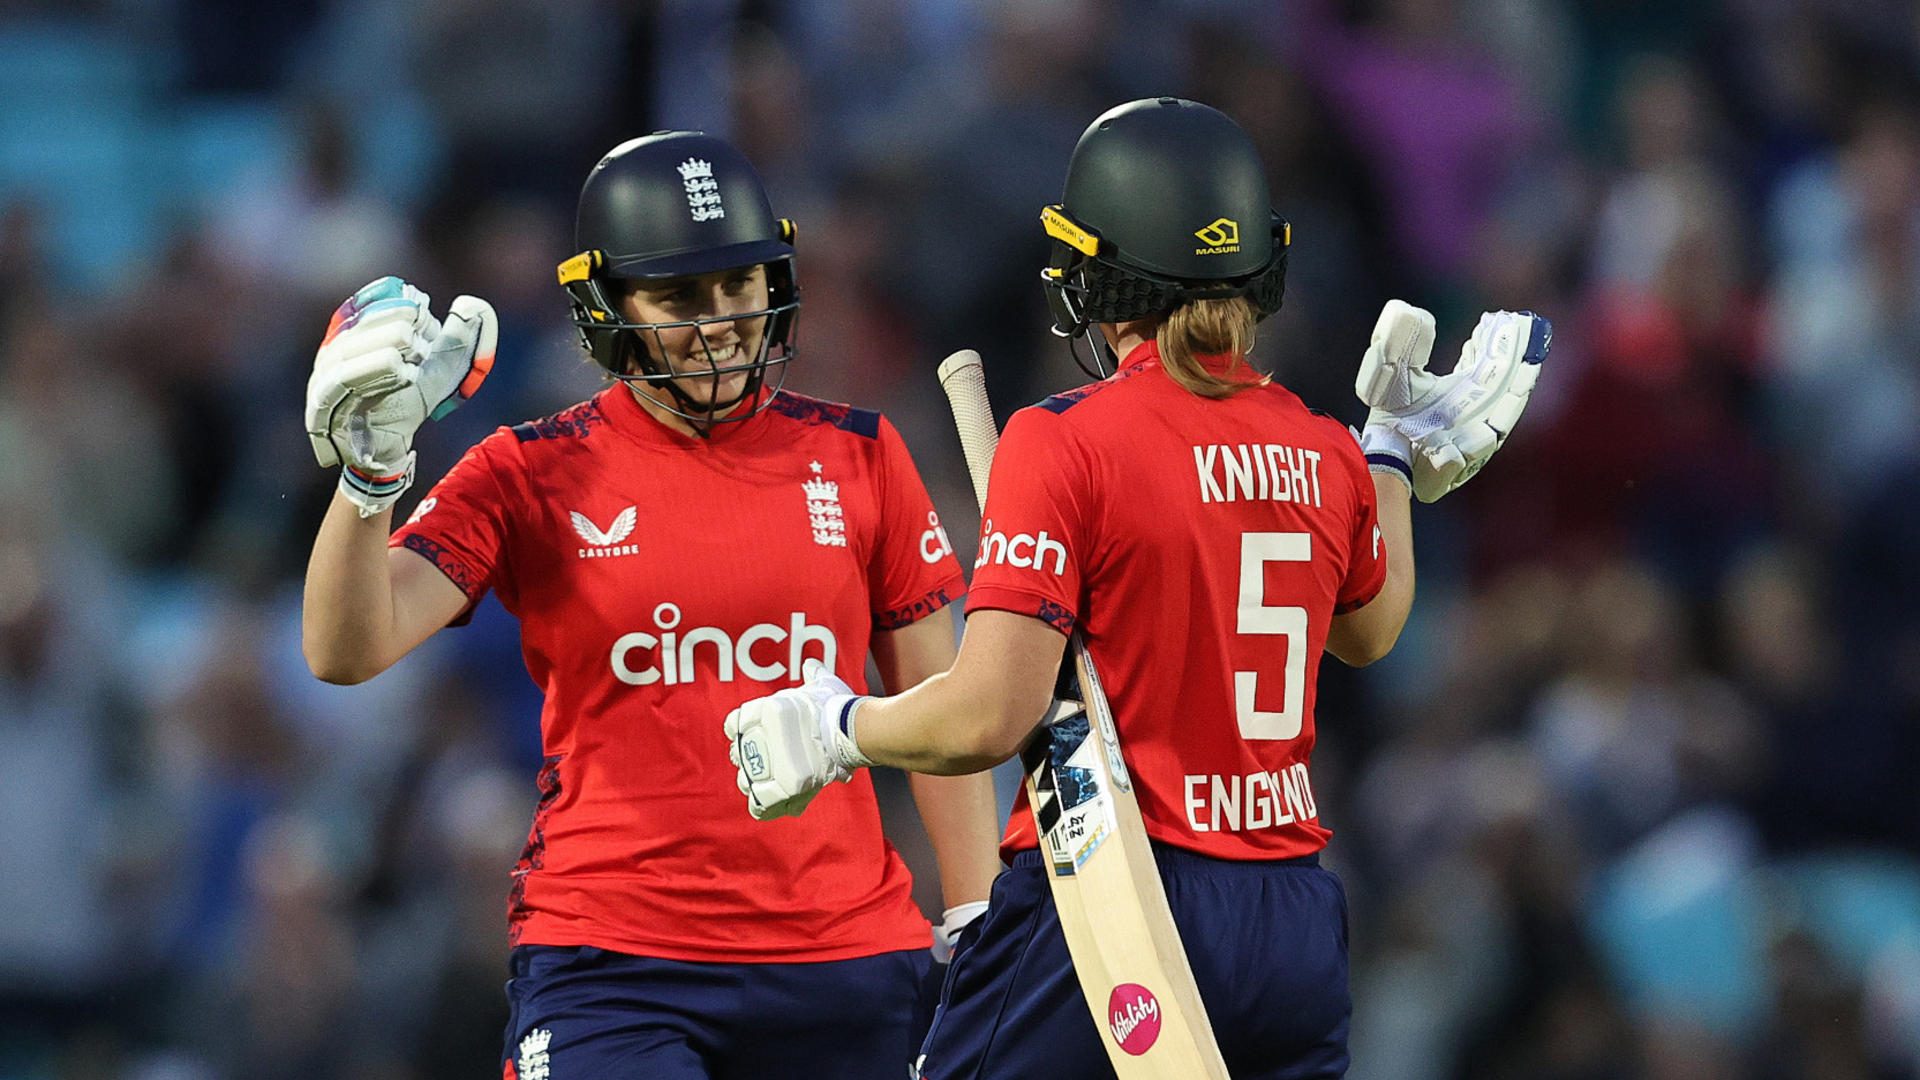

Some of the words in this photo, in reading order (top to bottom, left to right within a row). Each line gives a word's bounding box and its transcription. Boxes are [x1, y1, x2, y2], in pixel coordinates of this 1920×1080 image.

[1050, 216, 1077, 238] MASURI
[1195, 245, 1240, 256] MASURI
[1193, 443, 1321, 508] KNIGHT
[578, 544, 639, 559] CASTORE
[610, 602, 837, 686] cinch
[1234, 532, 1311, 740] 5
[1111, 995, 1158, 1044] Vitality
